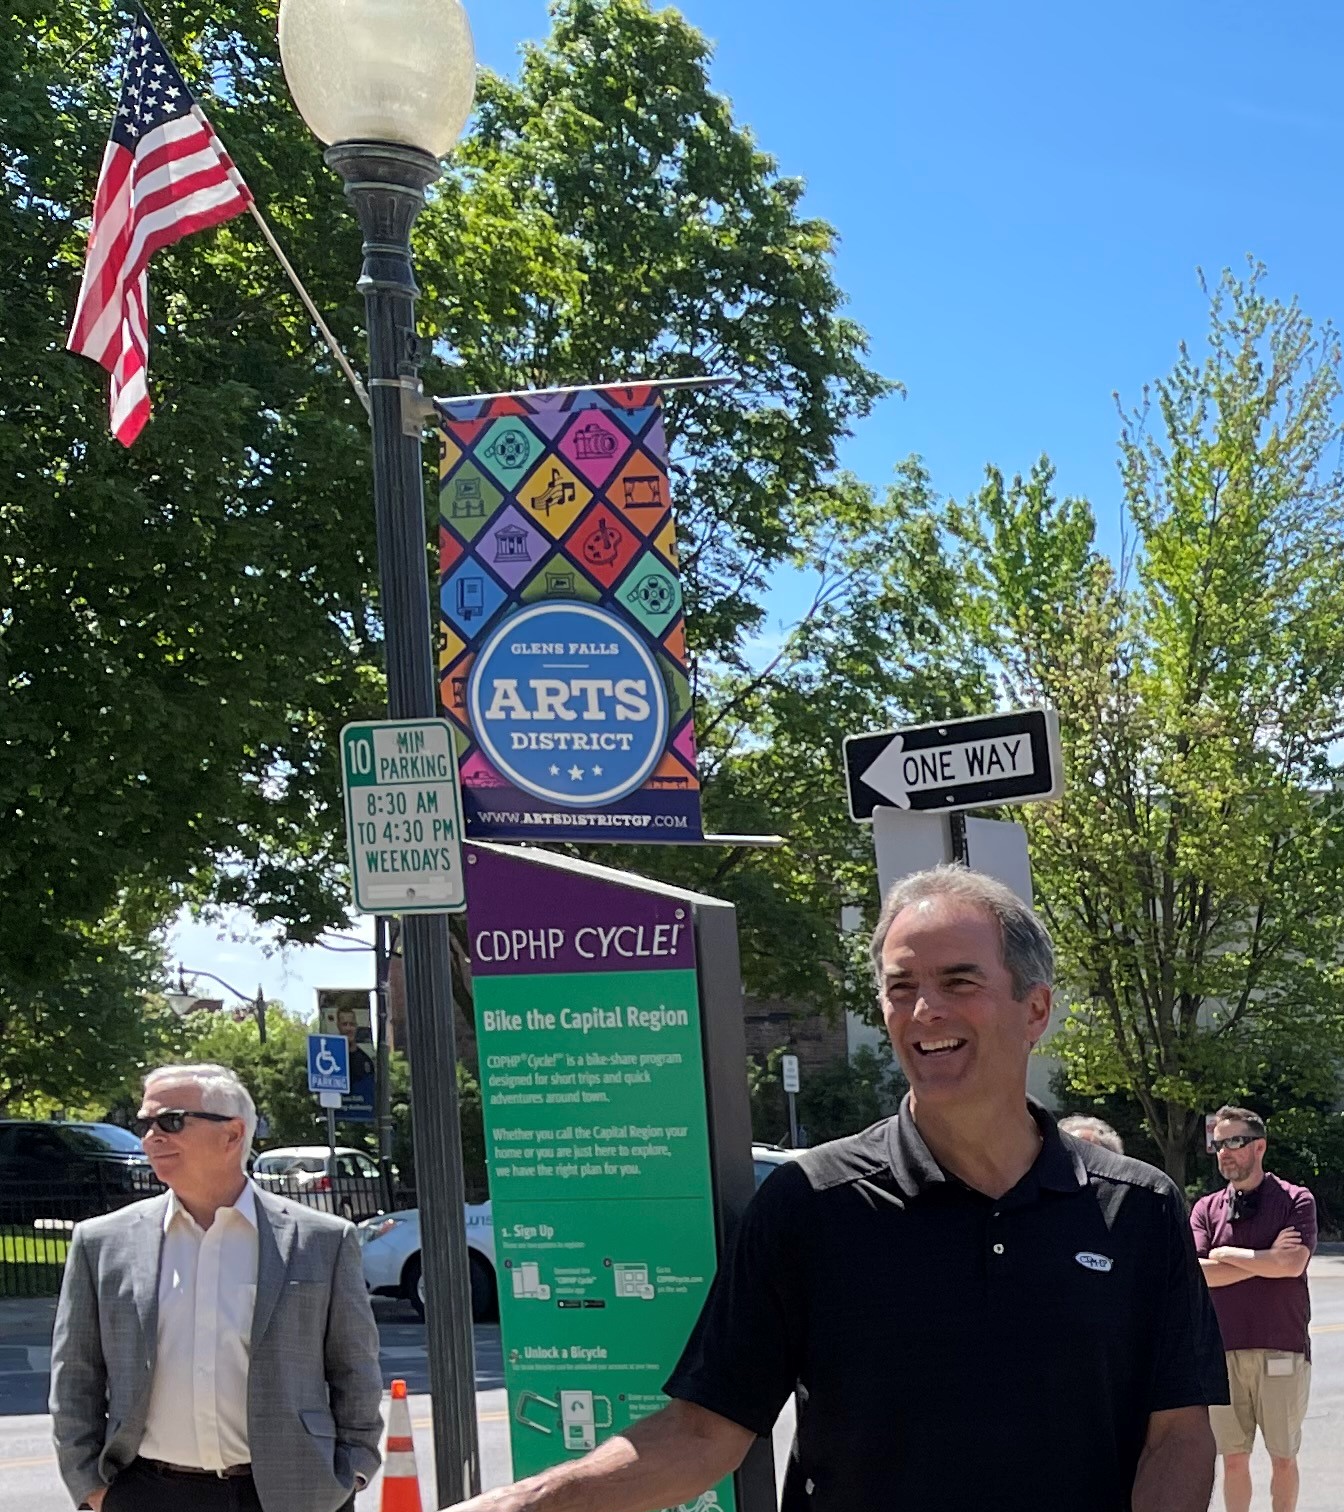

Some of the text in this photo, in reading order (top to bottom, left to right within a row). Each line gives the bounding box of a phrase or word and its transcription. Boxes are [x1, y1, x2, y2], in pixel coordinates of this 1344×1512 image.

[511, 642, 620, 656] GLENS FALLS
[485, 678, 651, 721] ARTS
[395, 730, 426, 753] MIN
[510, 731, 634, 751] DISTRICT
[348, 738, 373, 776] 10
[379, 754, 449, 780] PARKING
[902, 739, 1023, 787] ONE WAY
[366, 791, 440, 816] 8:30 AM
[357, 817, 456, 845] TO 4:30 PM
[477, 810, 689, 829] WWW.ARTSDISTRICTGF.COM
[364, 846, 451, 874] WEEKDAYS
[475, 925, 679, 962] CDPHP CYCLE!
[483, 1005, 688, 1034] Bike the Capital Region
[535, 1072, 548, 1085] for
[603, 1070, 622, 1084] and
[535, 1129, 555, 1143] you
[556, 1127, 573, 1140] call
[575, 1127, 592, 1140] the
[593, 1126, 628, 1142] Capital
[629, 1125, 664, 1141] Region
[665, 1127, 689, 1140] your
[536, 1149, 555, 1161] you
[495, 1167, 511, 1178] we
[537, 1164, 554, 1176] the
[604, 1162, 619, 1175] for
[501, 1224, 554, 1239] 1. Sign Up
[524, 1346, 560, 1360] Unlock
[561, 1348, 569, 1359] a
[570, 1346, 608, 1361] Bicycle
